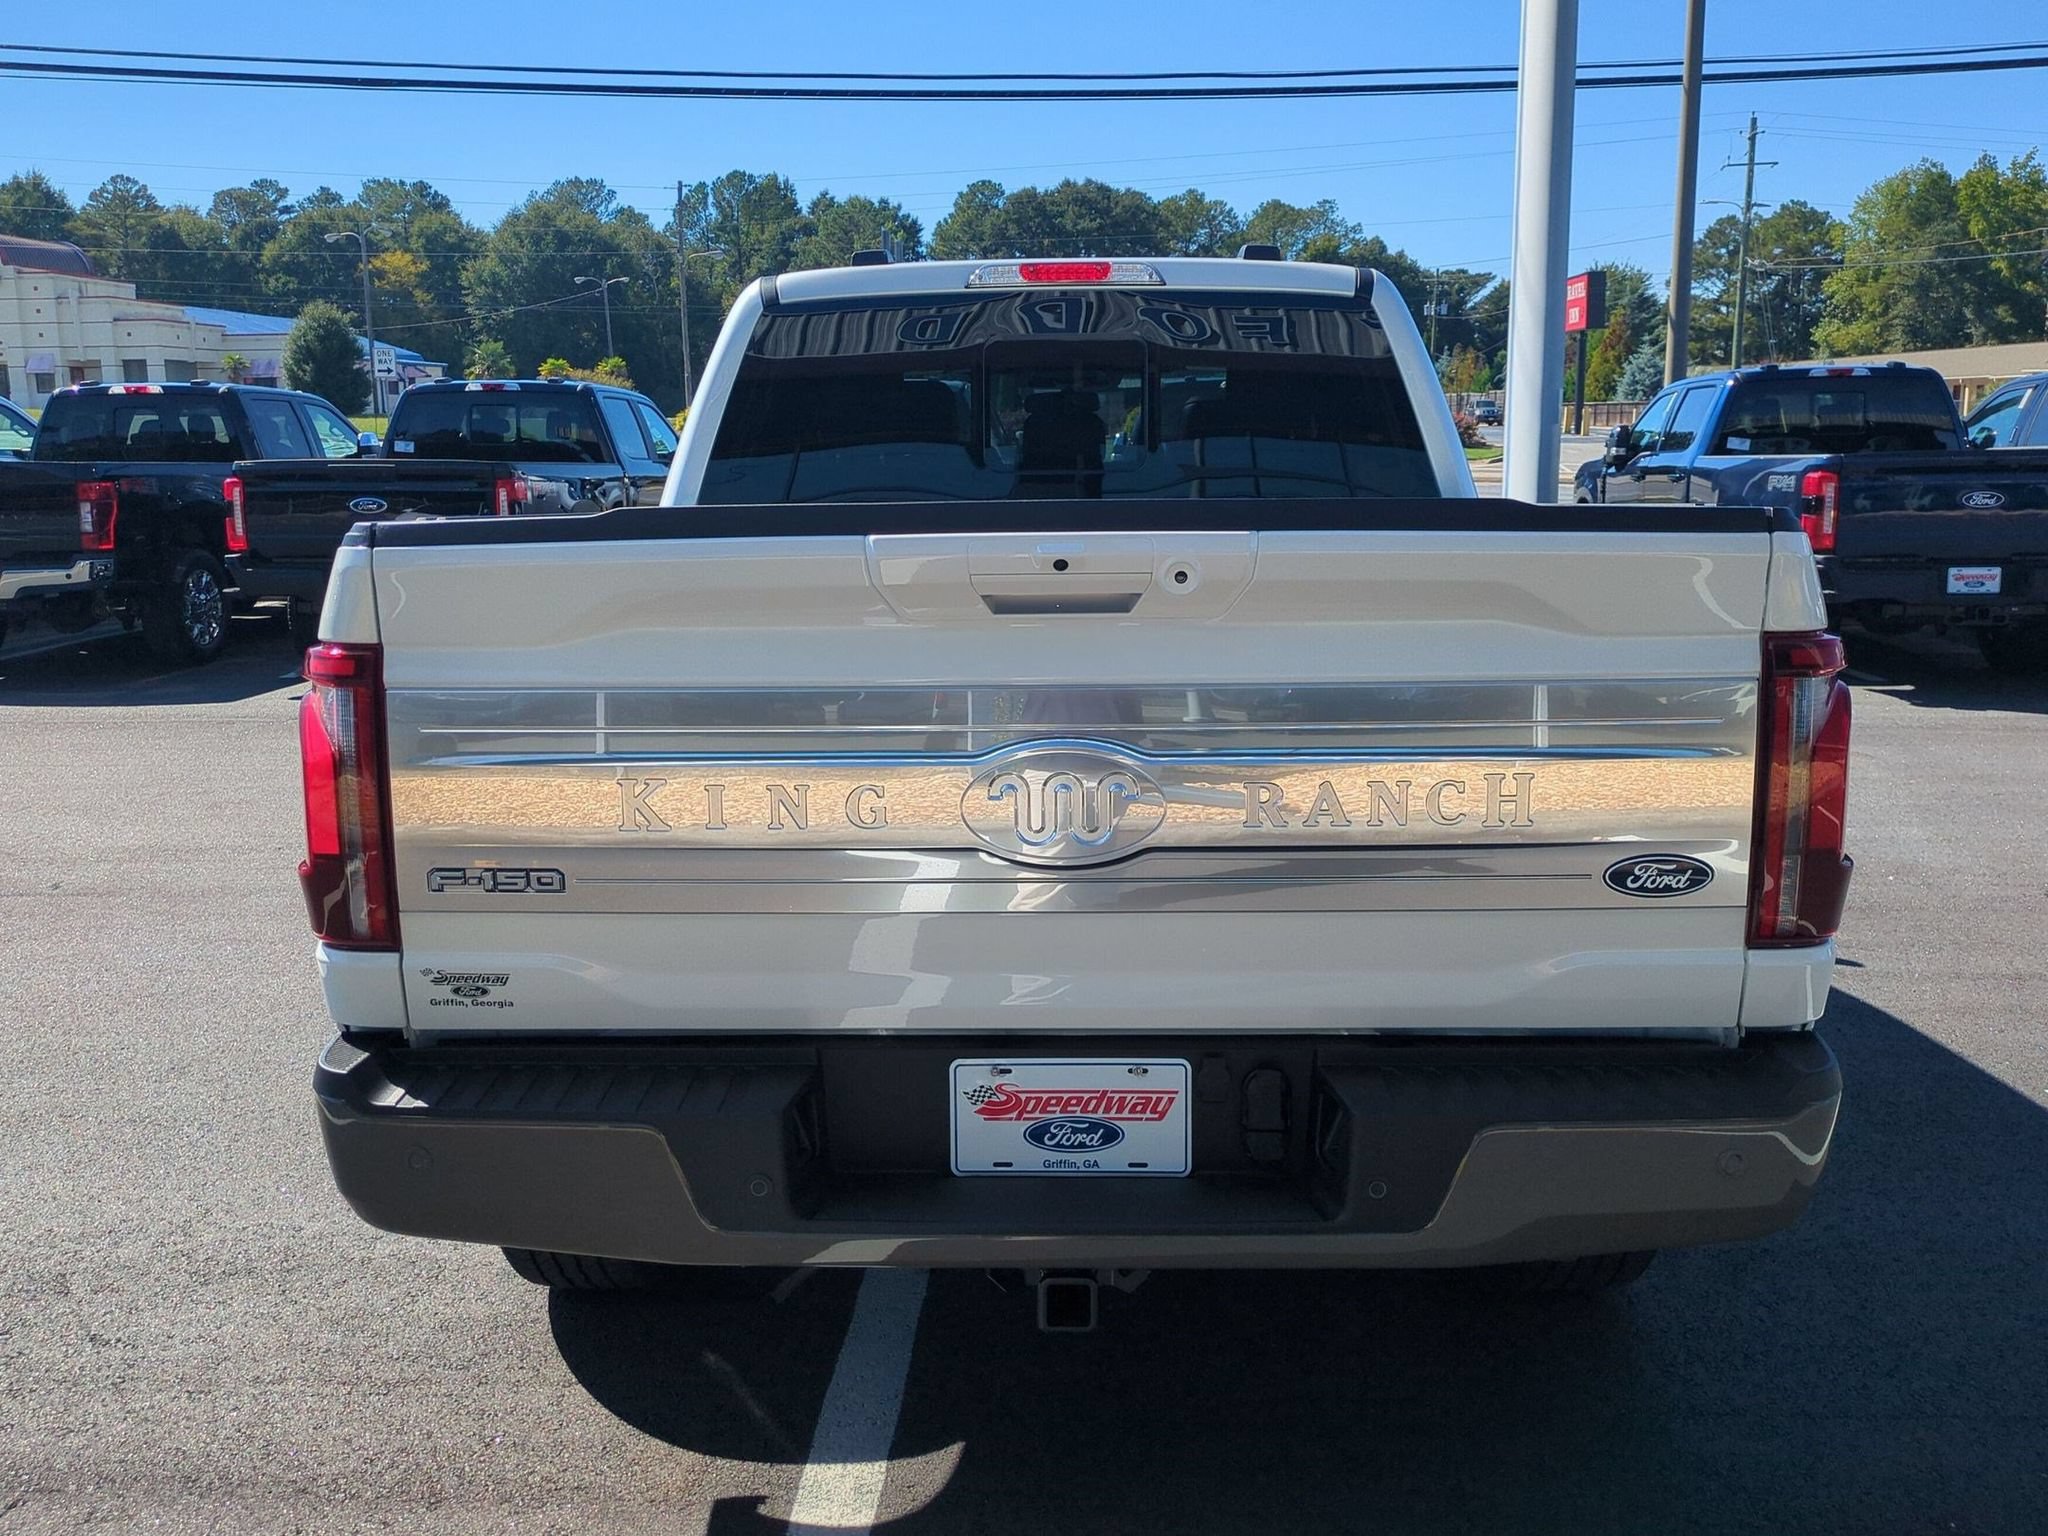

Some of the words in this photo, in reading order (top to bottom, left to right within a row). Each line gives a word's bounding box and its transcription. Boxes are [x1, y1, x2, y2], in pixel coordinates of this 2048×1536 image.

[1567, 282, 1586, 300] RAVEL
[1768, 475, 1797, 491] FX4
[617, 778, 888, 832] KING
[1243, 772, 1535, 827] RANCH
[427, 867, 568, 893] F-150
[430, 970, 511, 987] Speedway
[430, 998, 469, 1008] Griffin,
[471, 999, 514, 1009] Georgia
[974, 1083, 1178, 1121] Speedway
[1043, 1159, 1081, 1170] Griffin,
[1083, 1159, 1100, 1169] GA
